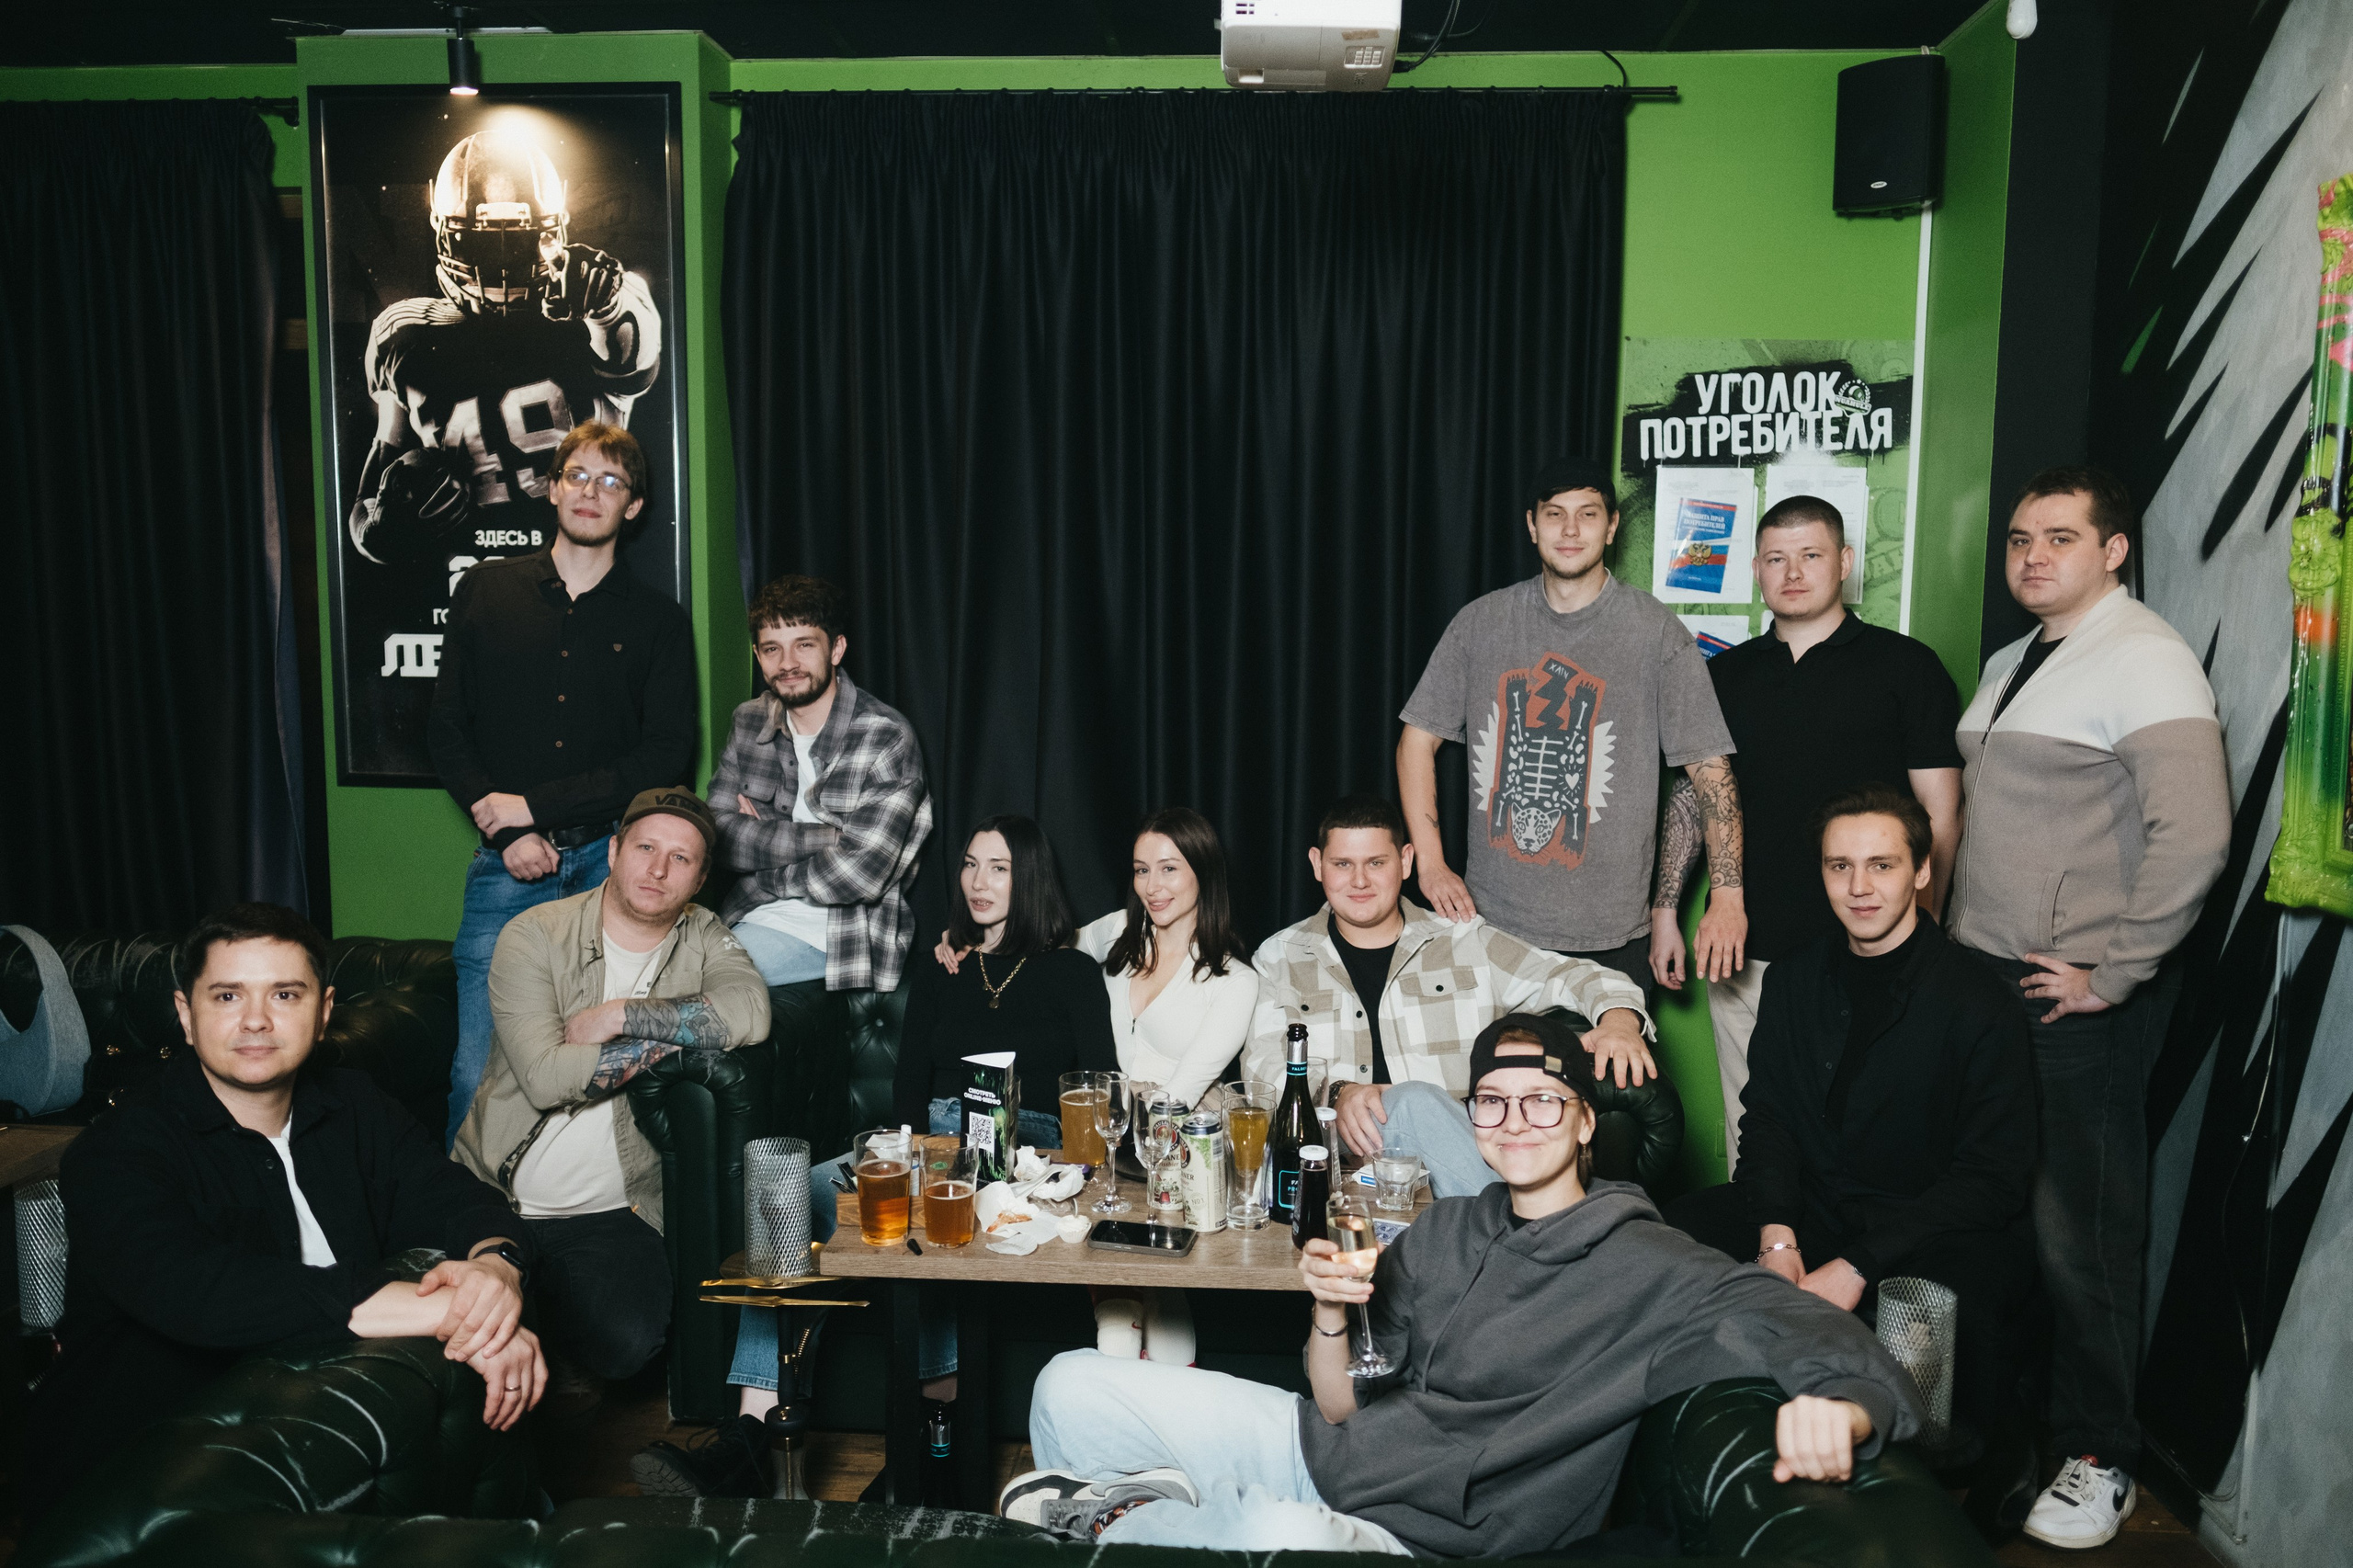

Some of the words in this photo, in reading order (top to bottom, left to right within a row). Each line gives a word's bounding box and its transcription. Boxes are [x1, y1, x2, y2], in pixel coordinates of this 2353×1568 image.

[1694, 371, 1842, 415] УГОЛОК
[1640, 407, 1893, 460] ПОТРЕБИТЕЛЯ
[474, 529, 529, 548] ЗДЕСЬ
[530, 529, 542, 546] В
